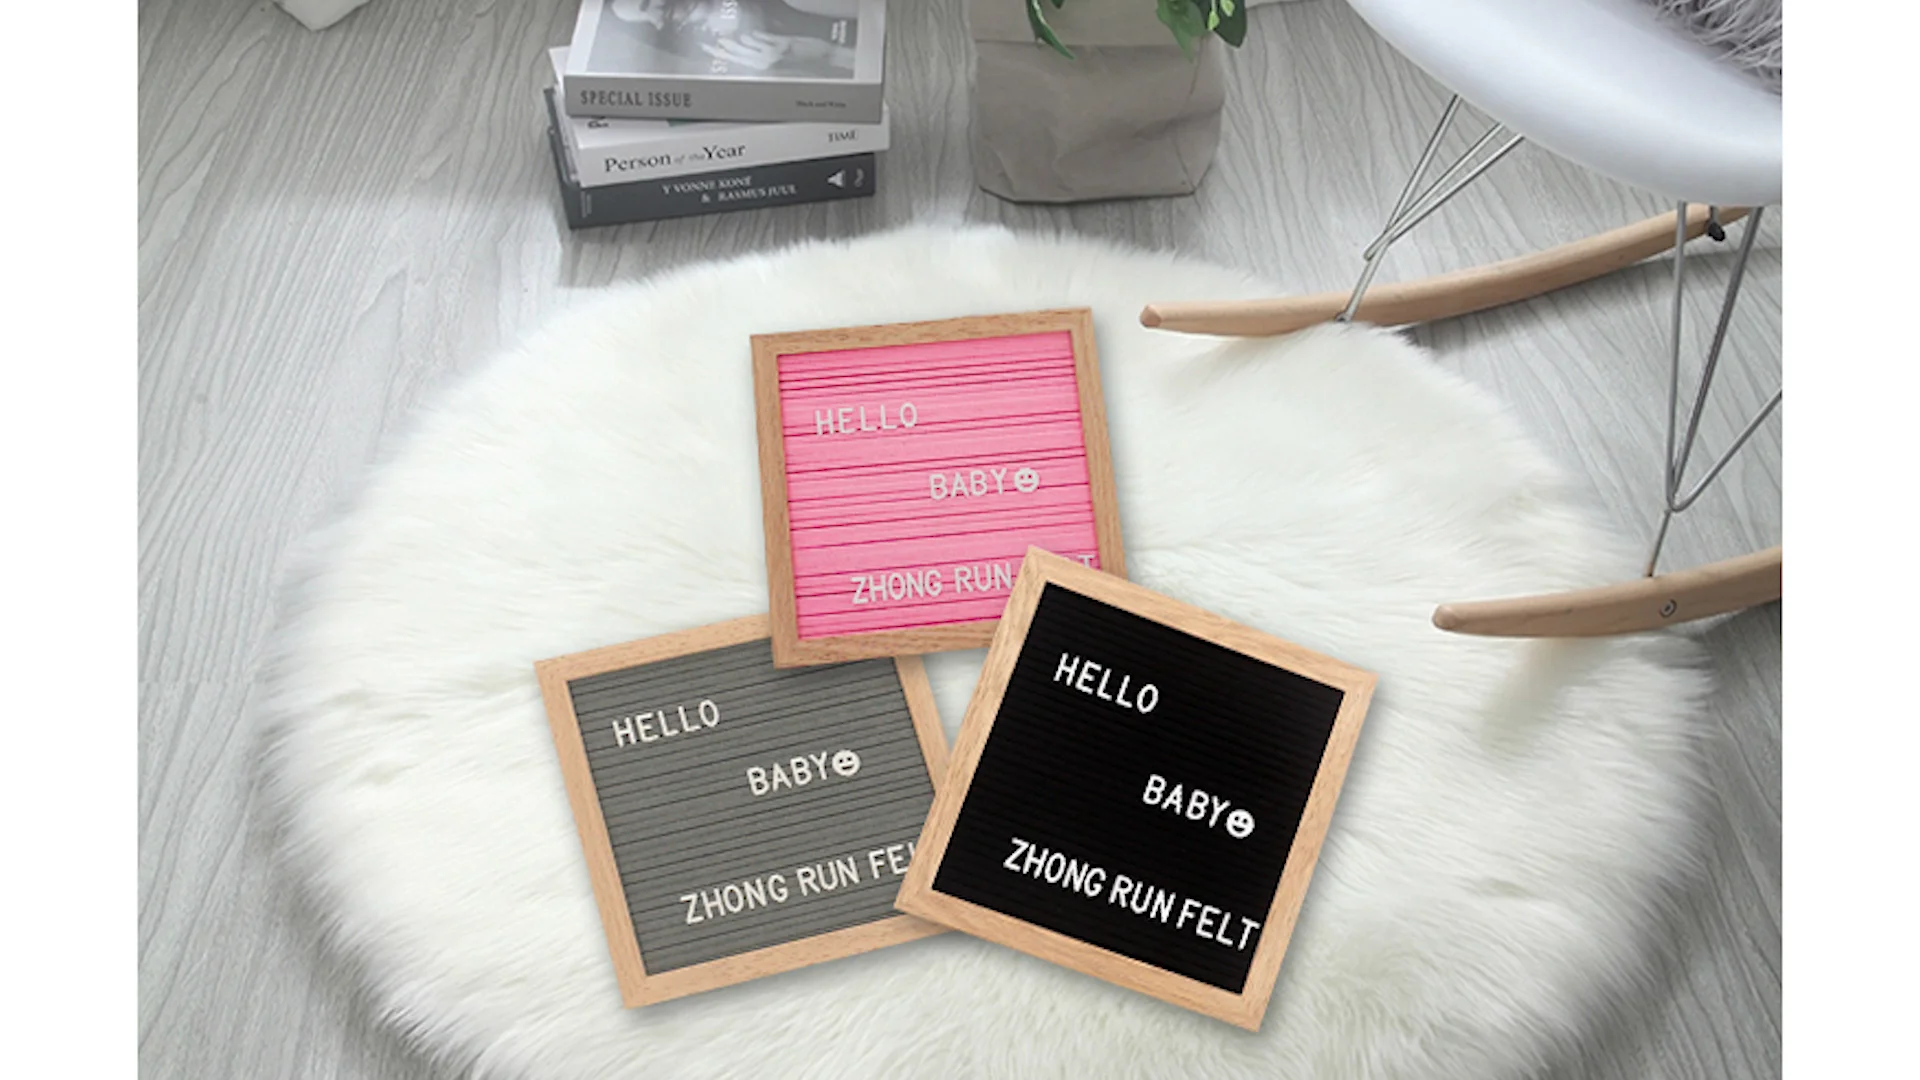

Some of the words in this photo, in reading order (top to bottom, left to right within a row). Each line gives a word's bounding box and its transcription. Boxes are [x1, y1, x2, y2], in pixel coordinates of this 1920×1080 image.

[580, 90, 644, 107] SPECIAL
[648, 91, 694, 108] ISSUE
[604, 153, 672, 172] Person
[702, 145, 746, 160] Year
[828, 131, 857, 143] TIME
[814, 402, 918, 436] HELLO
[929, 468, 1007, 500] BABY
[851, 569, 942, 605] ZHONG
[954, 562, 1013, 594] RUN
[1053, 652, 1160, 714] HELLO
[612, 699, 721, 748] HELLO
[746, 751, 829, 796] BABY
[1142, 773, 1231, 828] BABY
[680, 873, 788, 925] ZHONG
[796, 856, 860, 896] RUN
[1003, 837, 1107, 898] ZHONG
[1108, 874, 1176, 924] RUN
[1176, 898, 1262, 951] FELT
